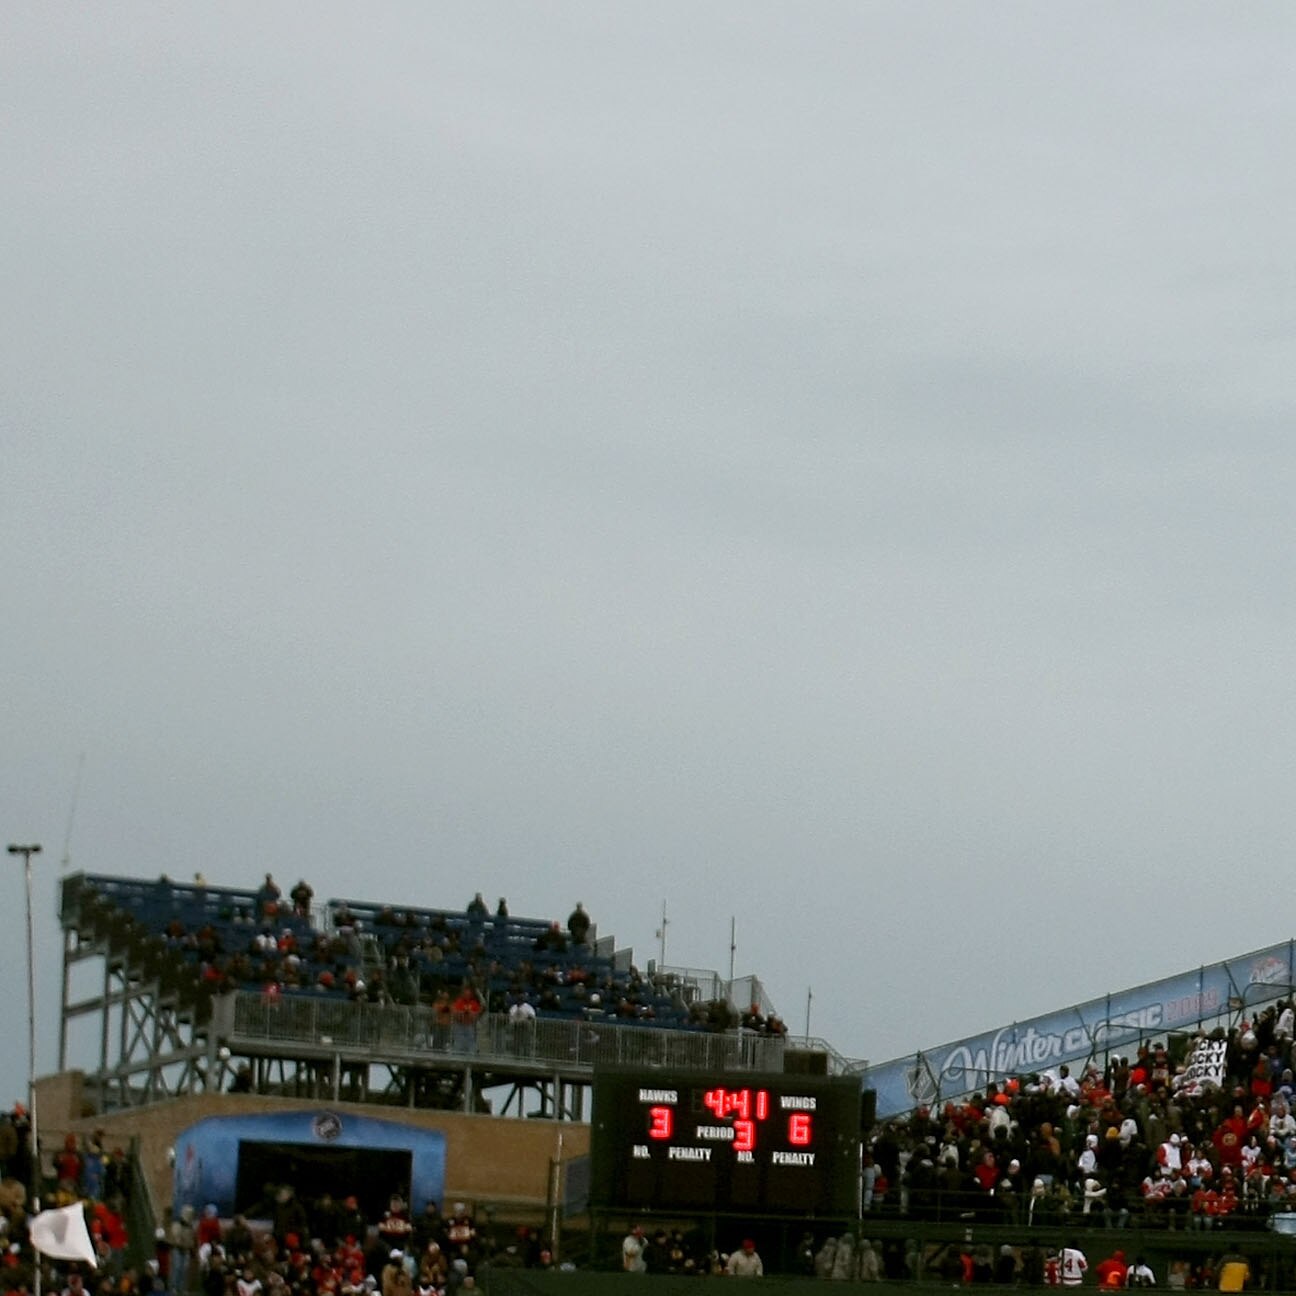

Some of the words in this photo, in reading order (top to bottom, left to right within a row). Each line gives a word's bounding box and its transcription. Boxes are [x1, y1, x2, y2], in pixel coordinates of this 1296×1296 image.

[941, 1026, 1065, 1091] Winter
[639, 1089, 677, 1102] HAWKS
[704, 1089, 769, 1120] 4:41
[780, 1096, 816, 1110] WINGS
[650, 1107, 671, 1139] 3
[697, 1126, 734, 1140] PERIOD
[734, 1120, 755, 1150] 3
[789, 1114, 811, 1144] 6
[633, 1145, 650, 1158] NO.
[669, 1147, 711, 1161] PENALTY
[737, 1150, 754, 1163] NO.
[773, 1152, 815, 1165] PENALTY
